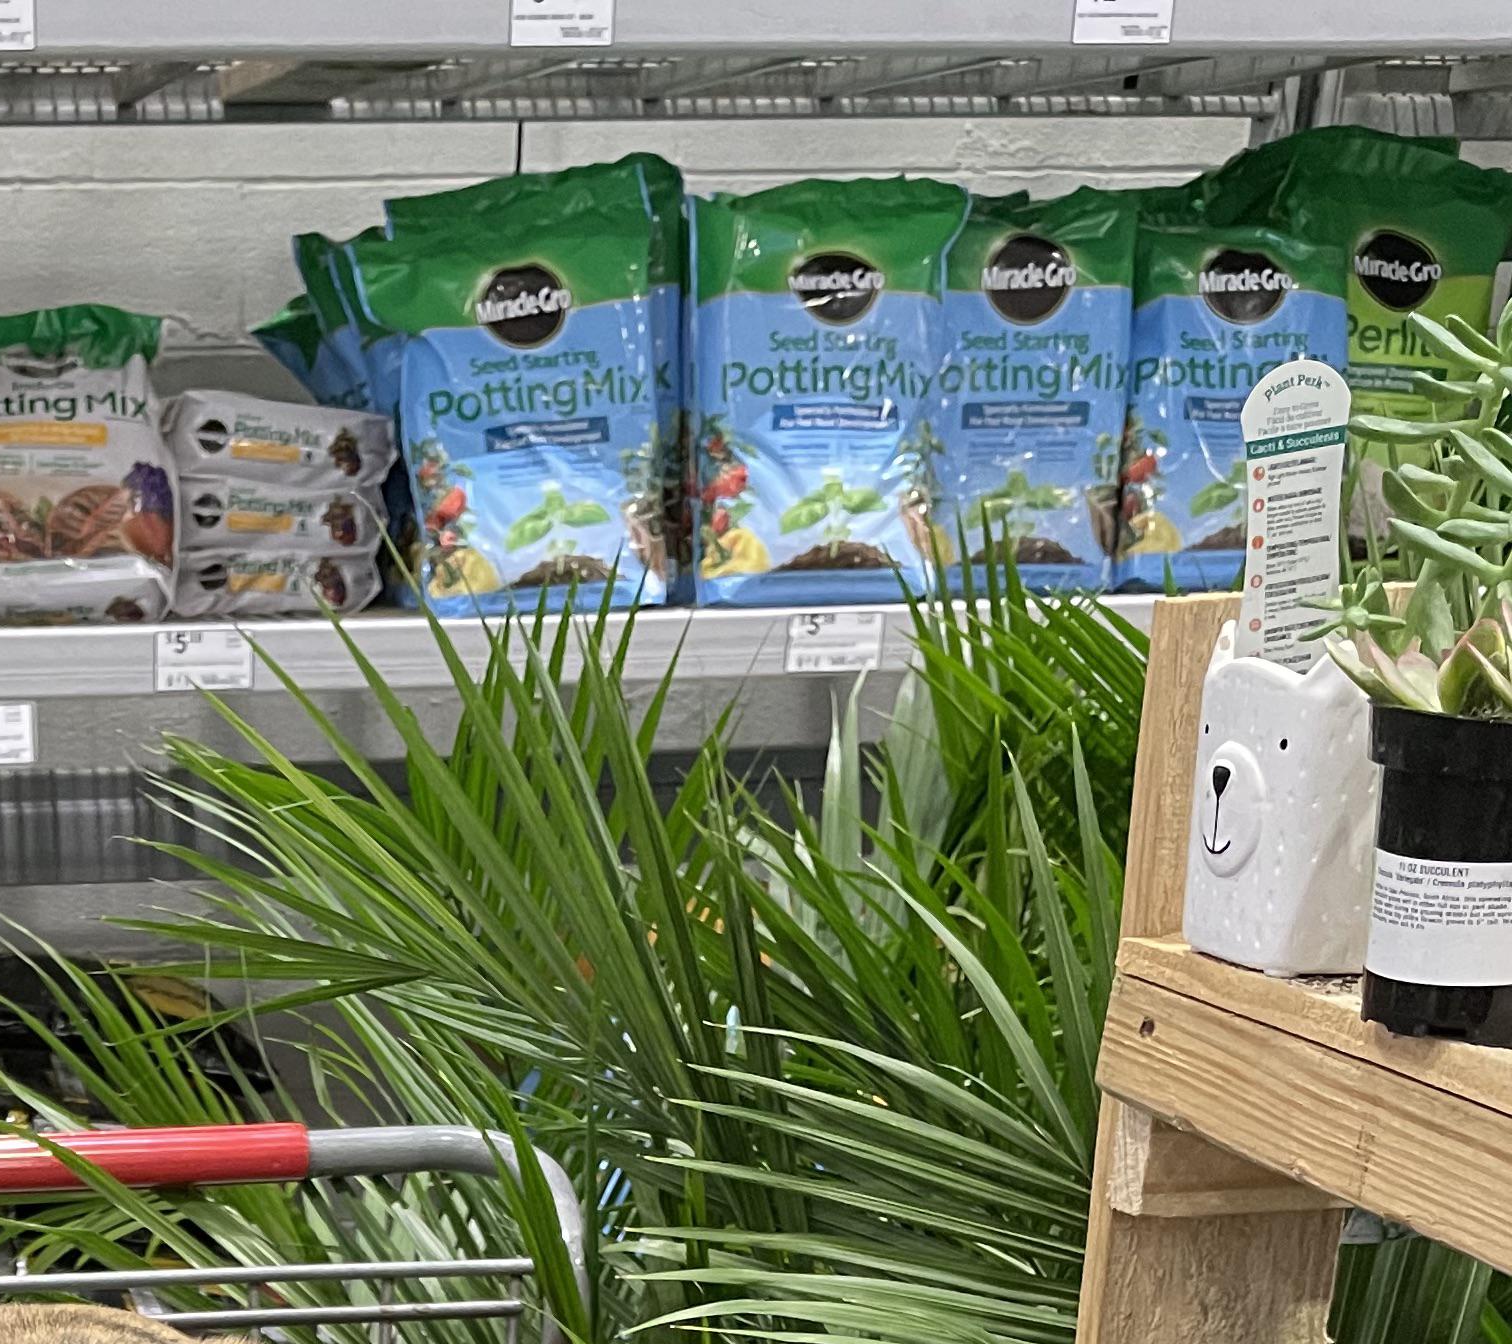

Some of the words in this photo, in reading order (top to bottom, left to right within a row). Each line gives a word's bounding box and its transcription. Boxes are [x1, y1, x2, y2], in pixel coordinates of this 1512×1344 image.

[769, 330, 818, 352] Seed
[961, 330, 1007, 350] Seed
[721, 356, 872, 403] Potting
[940, 354, 1062, 399] otting
[85, 389, 150, 419] Mix
[428, 375, 577, 428] Potting
[583, 365, 649, 407] Mix
